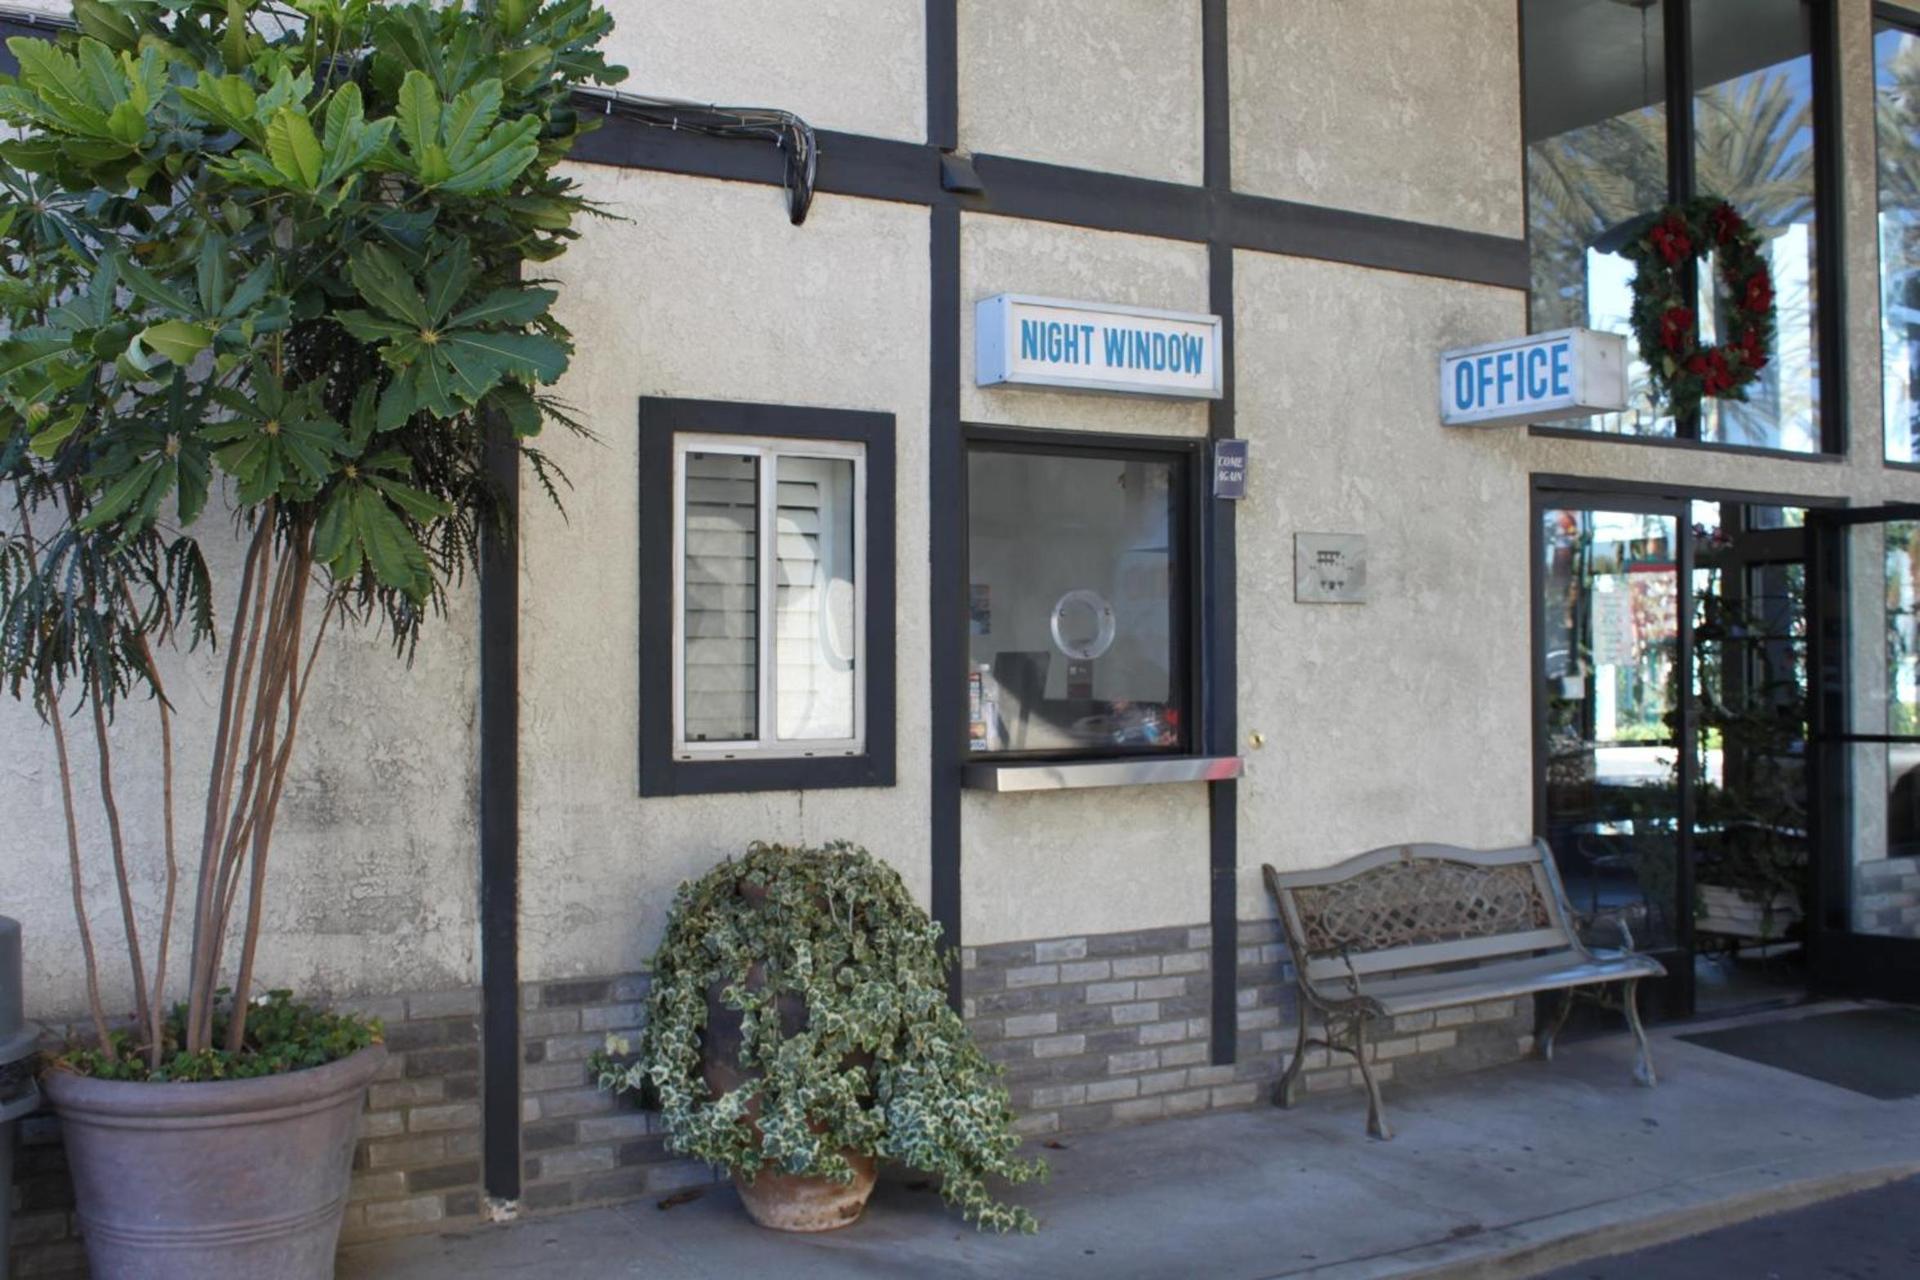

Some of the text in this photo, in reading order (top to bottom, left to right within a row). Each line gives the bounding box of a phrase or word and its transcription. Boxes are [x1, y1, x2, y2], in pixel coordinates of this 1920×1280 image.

[1021, 319, 1203, 375] NIGHT WINDOW
[1455, 343, 1569, 410] OFFICE
